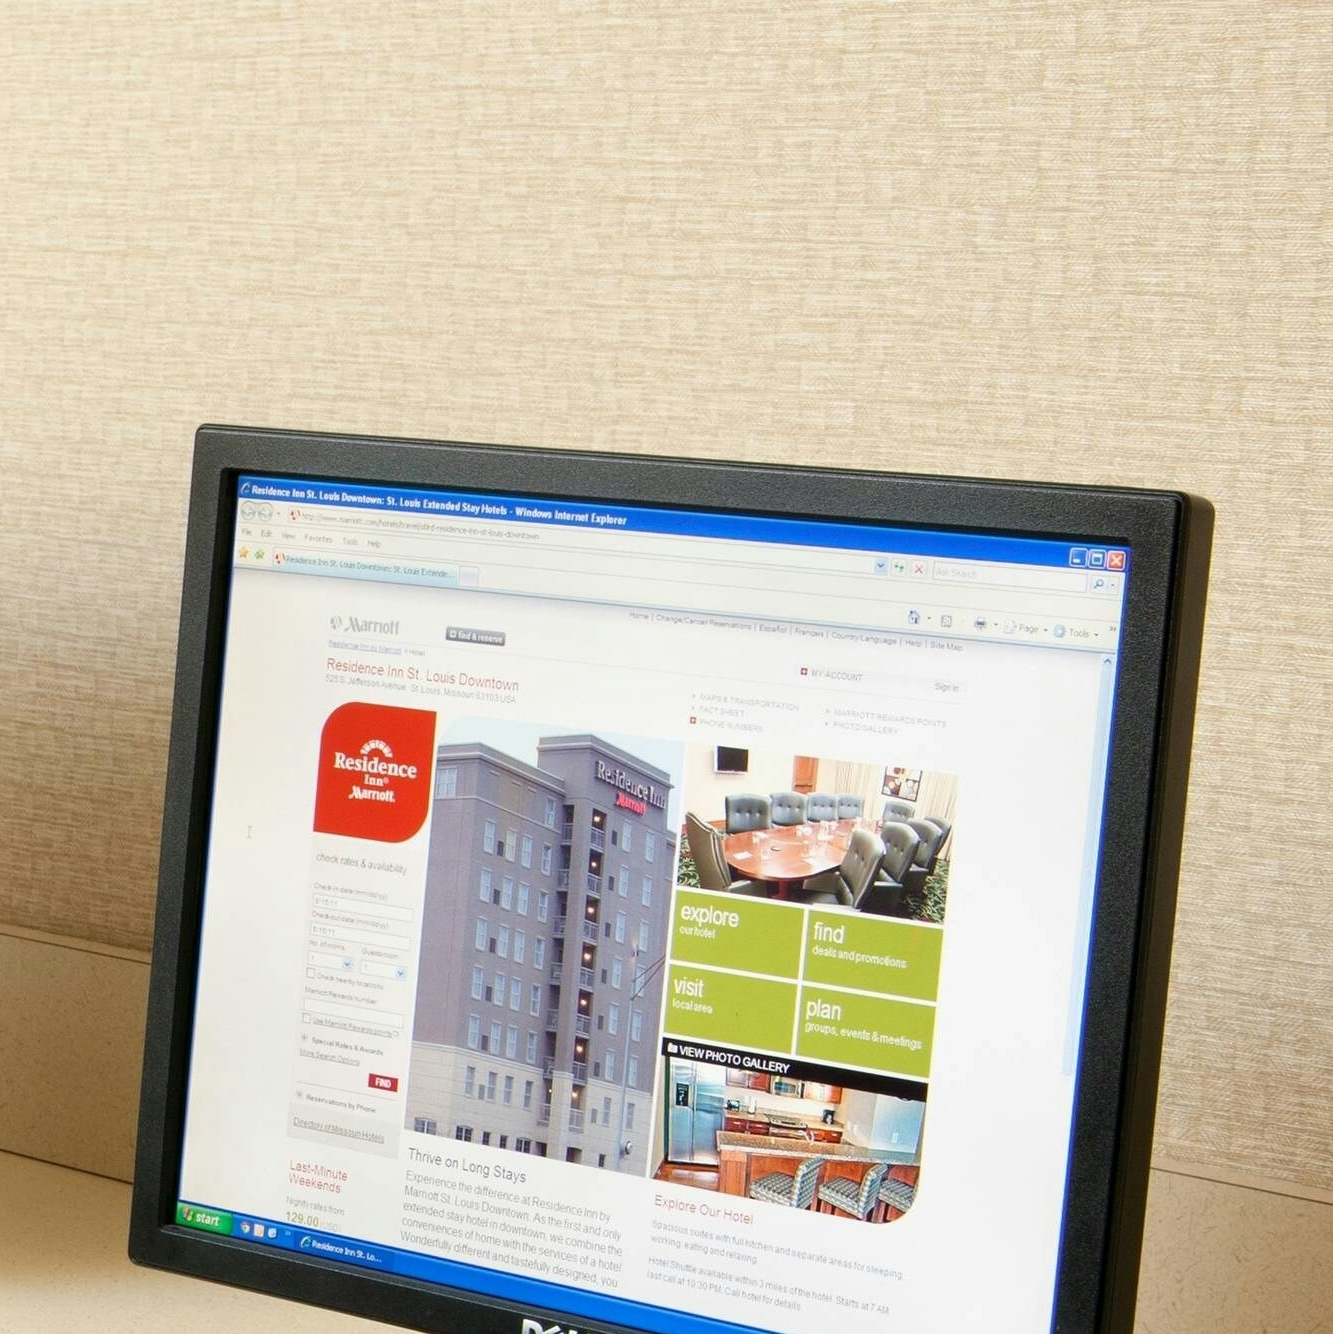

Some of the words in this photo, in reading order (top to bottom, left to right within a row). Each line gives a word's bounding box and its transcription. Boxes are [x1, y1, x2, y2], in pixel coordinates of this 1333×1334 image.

[252, 485, 290, 497] Residence
[292, 488, 305, 498] Inn
[307, 489, 317, 499] St.
[320, 490, 339, 501] Louis
[387, 496, 397, 506] St.
[400, 497, 421, 508] Louis
[423, 500, 461, 511] Extended
[462, 503, 480, 515] Stay
[482, 505, 507, 515] Hotels
[515, 507, 552, 519] Windows
[555, 510, 588, 522] Internet
[591, 513, 627, 526] Explorer
[344, 616, 399, 635] Marriott
[1019, 624, 1039, 634] Page
[1070, 628, 1090, 638] Tools
[326, 658, 384, 676] Residence
[388, 665, 404, 678] Inn
[408, 667, 422, 680] St.
[426, 671, 455, 685] Louis
[459, 673, 519, 691] Downtown
[334, 752, 417, 779] Residence
[597, 760, 649, 800] Residence
[649, 786, 666, 809] Inn
[317, 853, 338, 864] check
[341, 856, 359, 868] rates
[368, 862, 407, 876] availability
[681, 904, 740, 928] explore
[679, 926, 693, 936] our
[694, 927, 716, 939] hotel
[813, 922, 845, 944] find
[812, 946, 837, 959] deals
[838, 950, 854, 961] and
[855, 951, 907, 969] promotions
[674, 976, 704, 998] visit
[672, 998, 692, 1011] local
[693, 1004, 713, 1014] area
[805, 999, 841, 1021] plan
[805, 1021, 838, 1037] groups,
[841, 1028, 871, 1041] events
[880, 1033, 922, 1052] meetings
[679, 1045, 704, 1059] VIEW
[705, 1050, 742, 1066] PHOTO
[743, 1057, 790, 1075] GALLERY
[375, 1078, 391, 1088] FIND
[290, 1159, 348, 1181] Last-Minute
[409, 1147, 442, 1166] Thrive
[445, 1156, 459, 1169] on
[462, 1158, 490, 1178] Long
[494, 1165, 526, 1183] Stays
[289, 1174, 341, 1193] Weekends
[406, 1170, 457, 1190] Experience
[458, 1181, 472, 1194] the
[474, 1184, 520, 1203] difference
[522, 1195, 530, 1205] at
[533, 1196, 583, 1216] Residence
[584, 1208, 597, 1219] Inn
[599, 1211, 611, 1224] by
[195, 1213, 219, 1226] start
[286, 1211, 319, 1227] 129.00
[405, 1185, 439, 1201] Marriott
[455, 1193, 480, 1210] Louis
[533, 1213, 546, 1224] As
[547, 1215, 562, 1228] the
[563, 1219, 582, 1232] first
[583, 1222, 601, 1236] and
[602, 1228, 621, 1242] only
[654, 1194, 697, 1216] Explore
[699, 1203, 721, 1218] Our
[723, 1208, 754, 1226] Hotel
